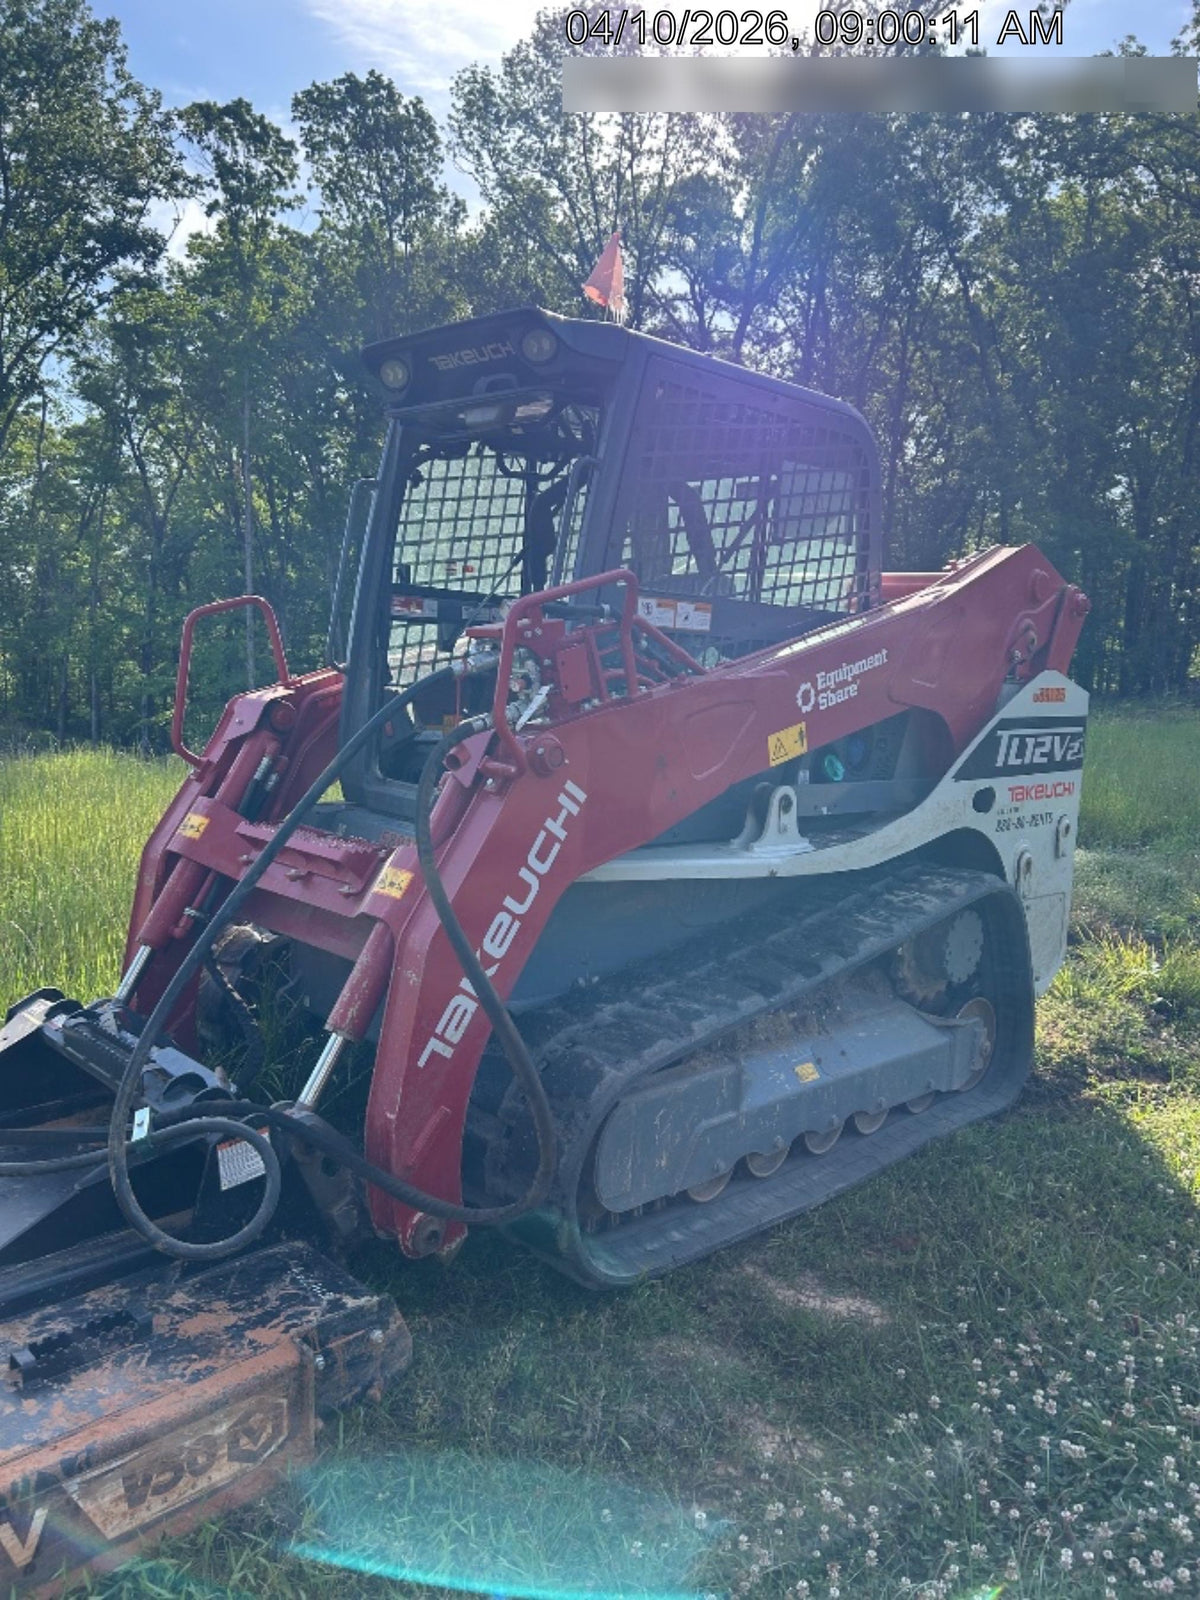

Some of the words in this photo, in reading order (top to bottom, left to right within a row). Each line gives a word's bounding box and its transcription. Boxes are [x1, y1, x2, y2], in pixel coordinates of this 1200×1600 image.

[816, 648, 888, 690] Equipment
[818, 682, 859, 710] Share
[1007, 781, 1075, 802] TAKEUCHI
